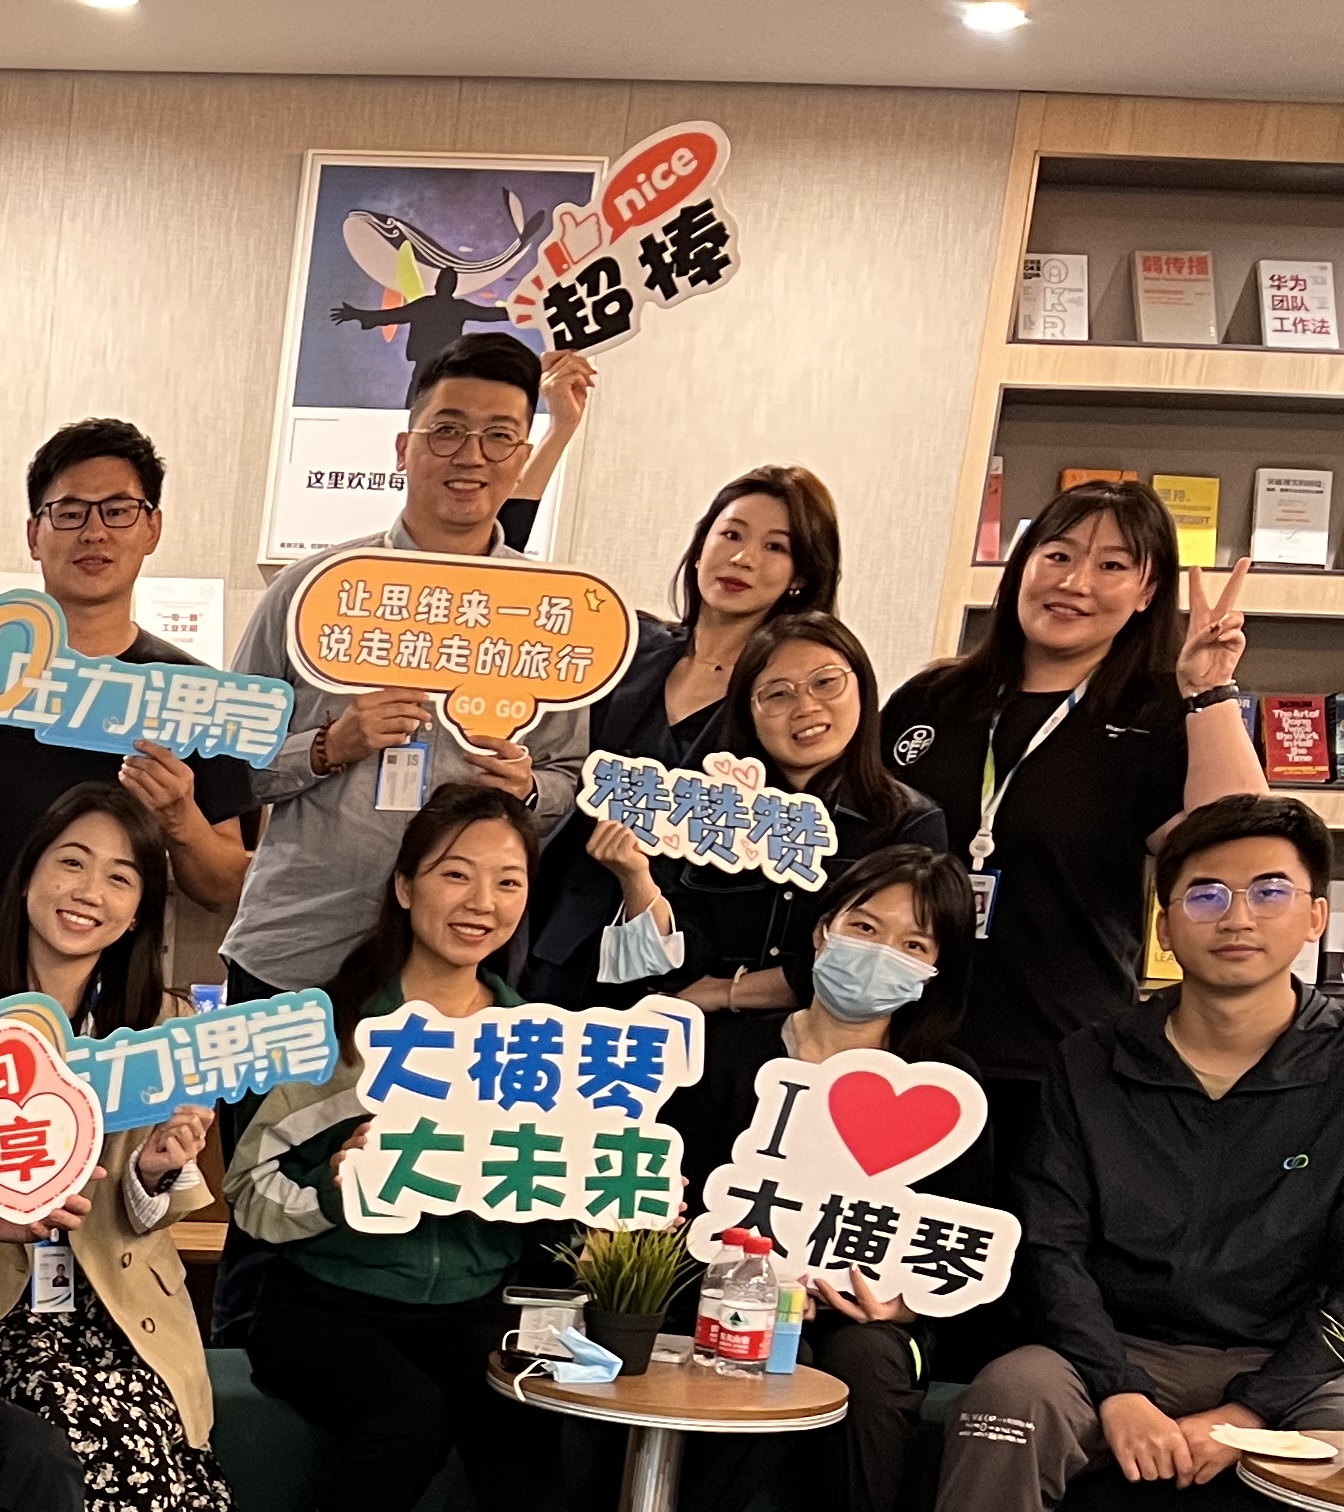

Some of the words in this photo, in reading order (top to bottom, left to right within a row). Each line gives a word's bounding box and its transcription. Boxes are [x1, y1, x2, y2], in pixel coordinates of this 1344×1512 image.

[615, 147, 698, 221] nice
[542, 199, 732, 352] 超棒
[1269, 273, 1307, 292] 华为
[1271, 294, 1310, 312] 团队
[1272, 316, 1331, 335] 工作法
[305, 470, 406, 491] 这里欢迎每
[337, 578, 574, 635] 让思维来一场
[316, 622, 595, 685] 说走就走的旅行
[453, 695, 487, 719] GO
[493, 699, 529, 721] GO
[1272, 709, 1292, 718] The
[588, 757, 831, 884] 赞赞赞
[367, 1013, 671, 1120] 大横琴
[758, 1080, 810, 1160] I
[378, 1116, 672, 1217] 大未来
[711, 1178, 996, 1297] 大横琴
